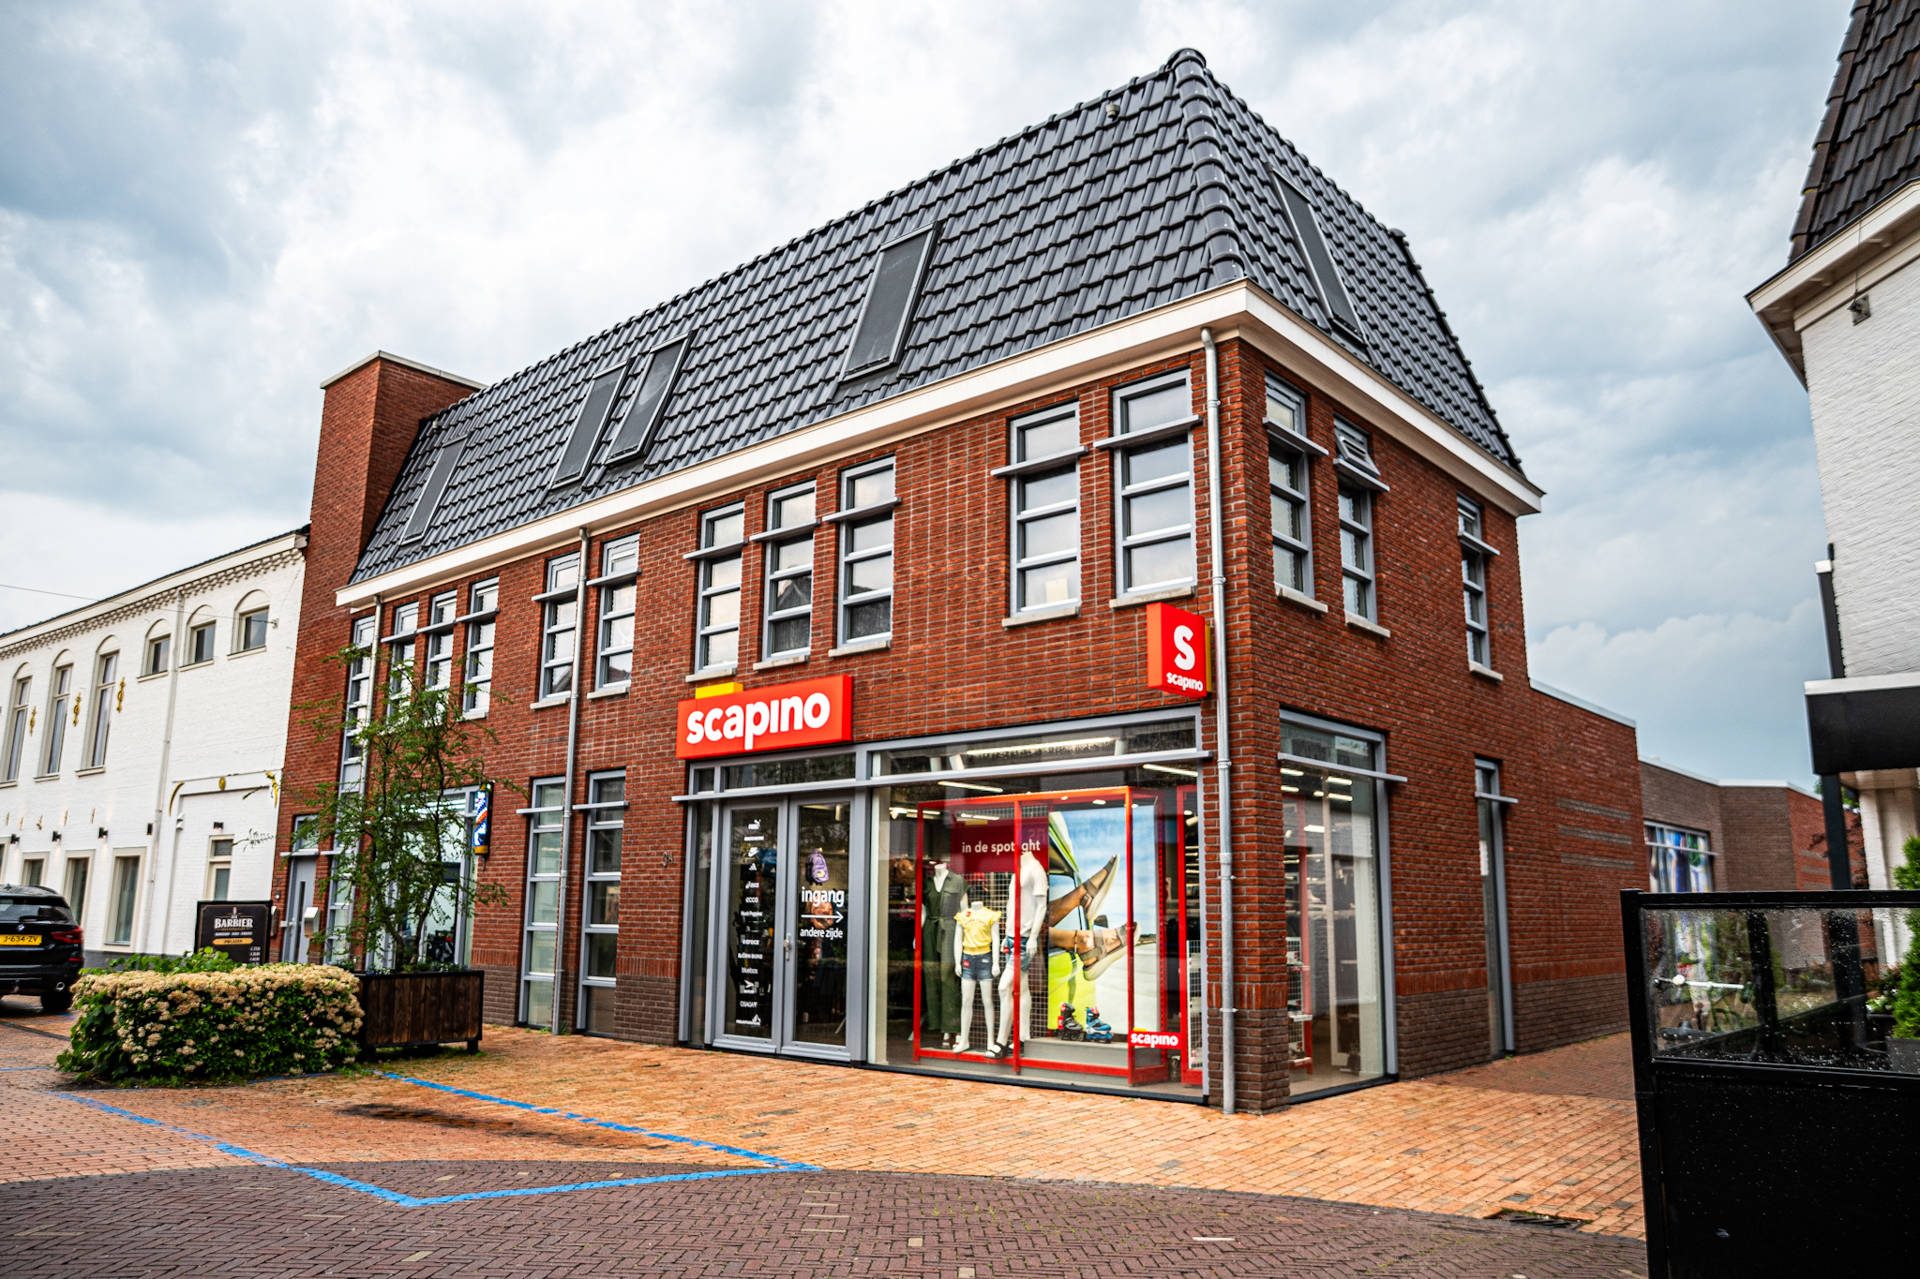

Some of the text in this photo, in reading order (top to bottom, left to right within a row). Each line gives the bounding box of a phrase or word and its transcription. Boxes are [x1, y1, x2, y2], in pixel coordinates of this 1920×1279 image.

[1174, 625, 1195, 671] S
[1166, 672, 1203, 691] scapino
[686, 692, 831, 750] scapino
[962, 842, 971, 853] in
[975, 840, 988, 853] de
[801, 886, 845, 907] ingang
[214, 918, 253, 929] BARBIER
[800, 927, 843, 940] andere zijde
[1130, 1033, 1179, 1048] scapino
